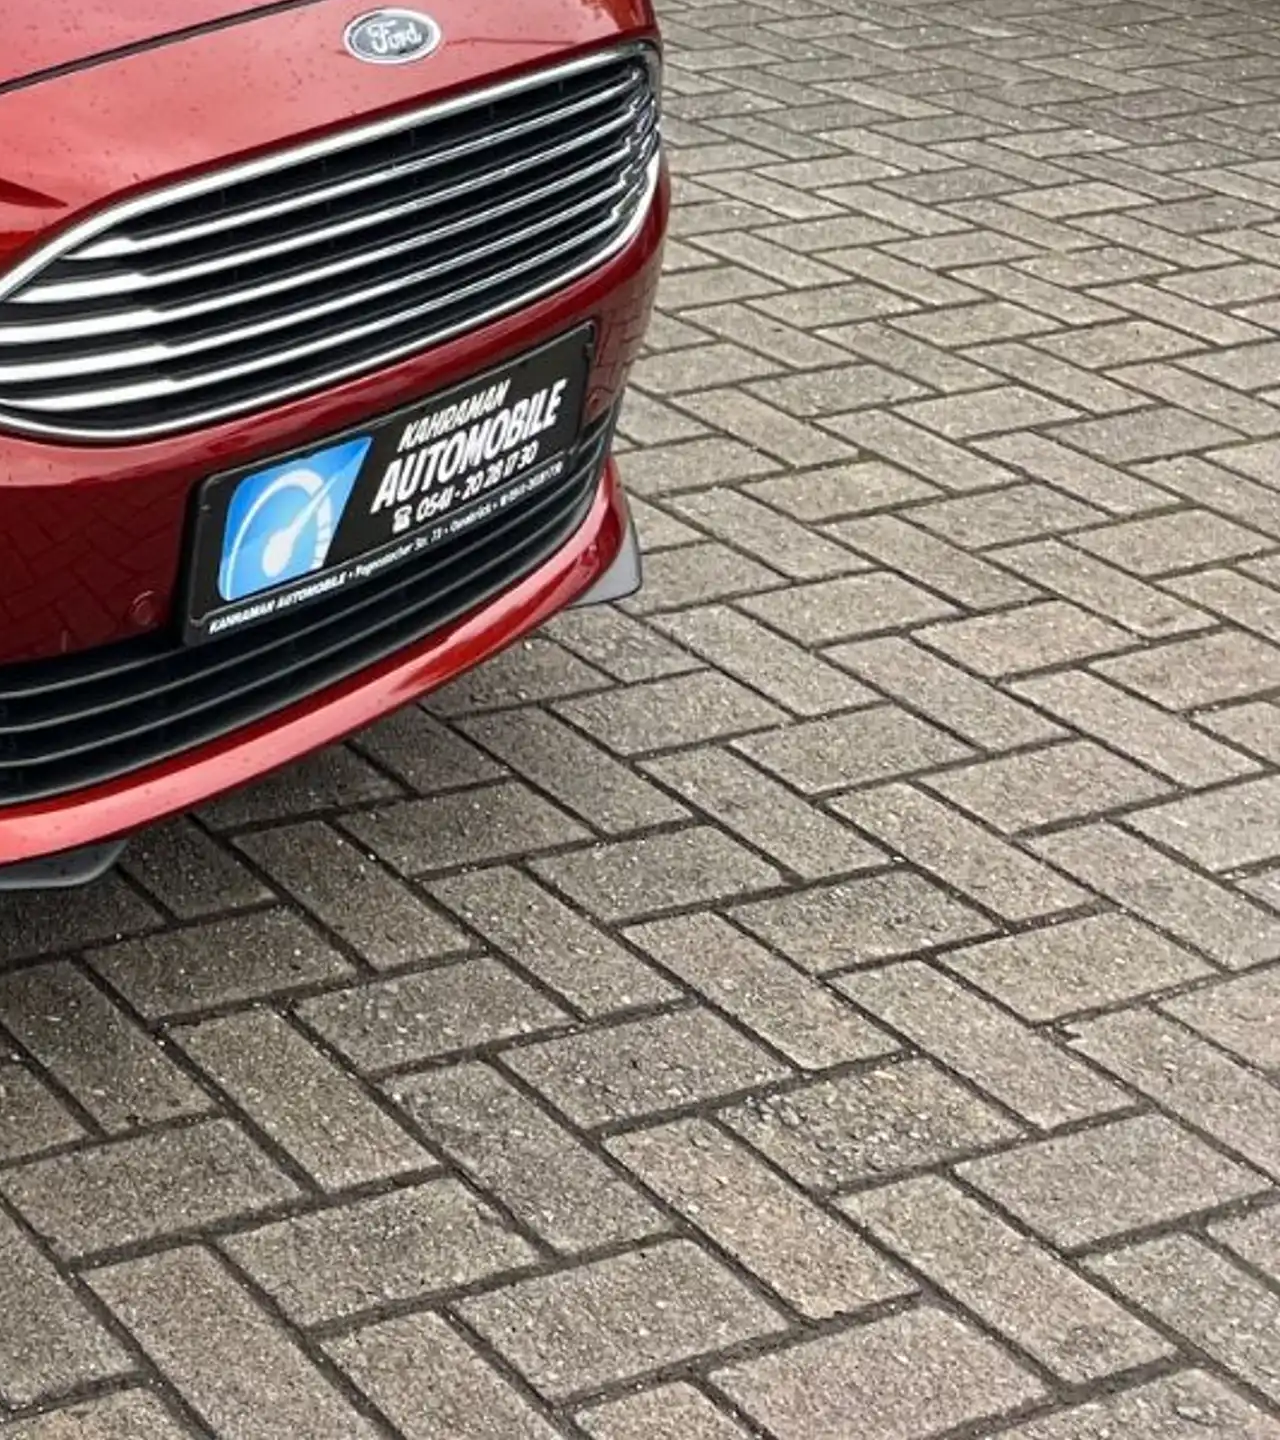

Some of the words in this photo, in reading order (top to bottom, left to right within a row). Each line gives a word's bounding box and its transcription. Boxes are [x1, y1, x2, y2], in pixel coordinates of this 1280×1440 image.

[366, 20, 422, 54] Ford
[396, 378, 512, 453] KAHRAMAN
[369, 377, 569, 514] AUTOMOBILE
[275, 570, 348, 610] AUTOMOBILE
